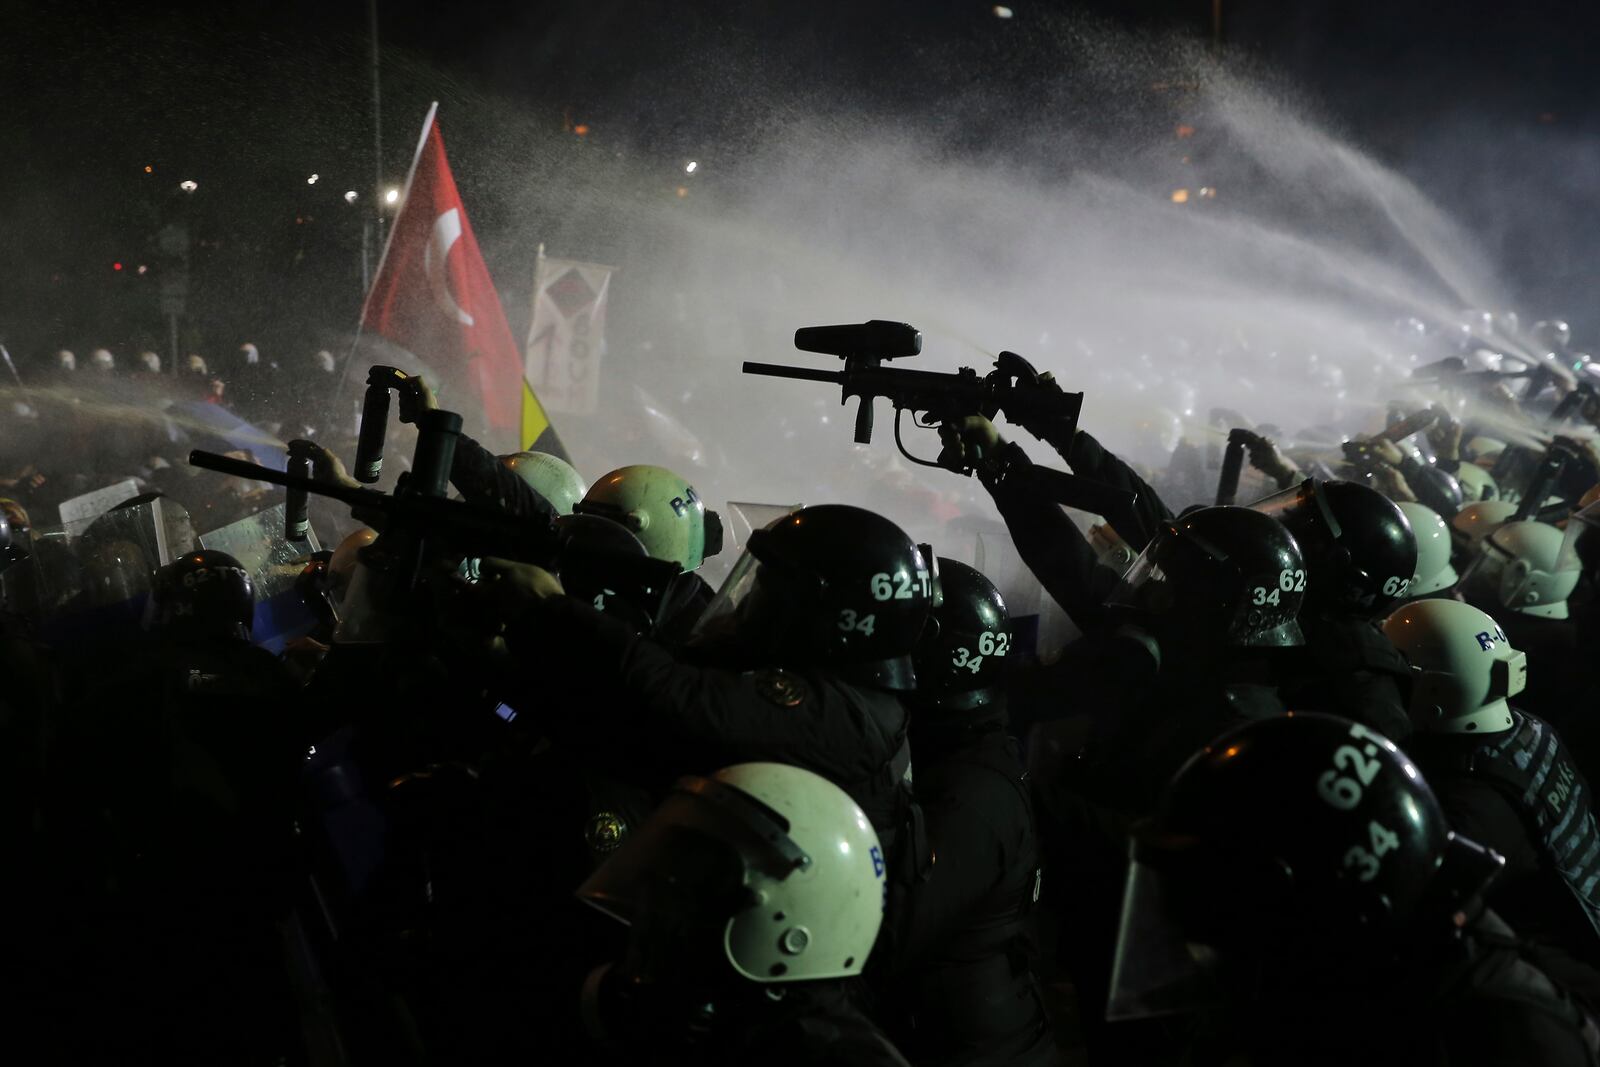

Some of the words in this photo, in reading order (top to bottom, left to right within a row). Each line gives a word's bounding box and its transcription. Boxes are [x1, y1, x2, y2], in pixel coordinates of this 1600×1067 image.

[871, 569, 932, 601] 62-T
[1252, 587, 1281, 607] 34
[837, 608, 877, 637] 34
[952, 647, 983, 674] 34
[1343, 819, 1400, 883] 34
